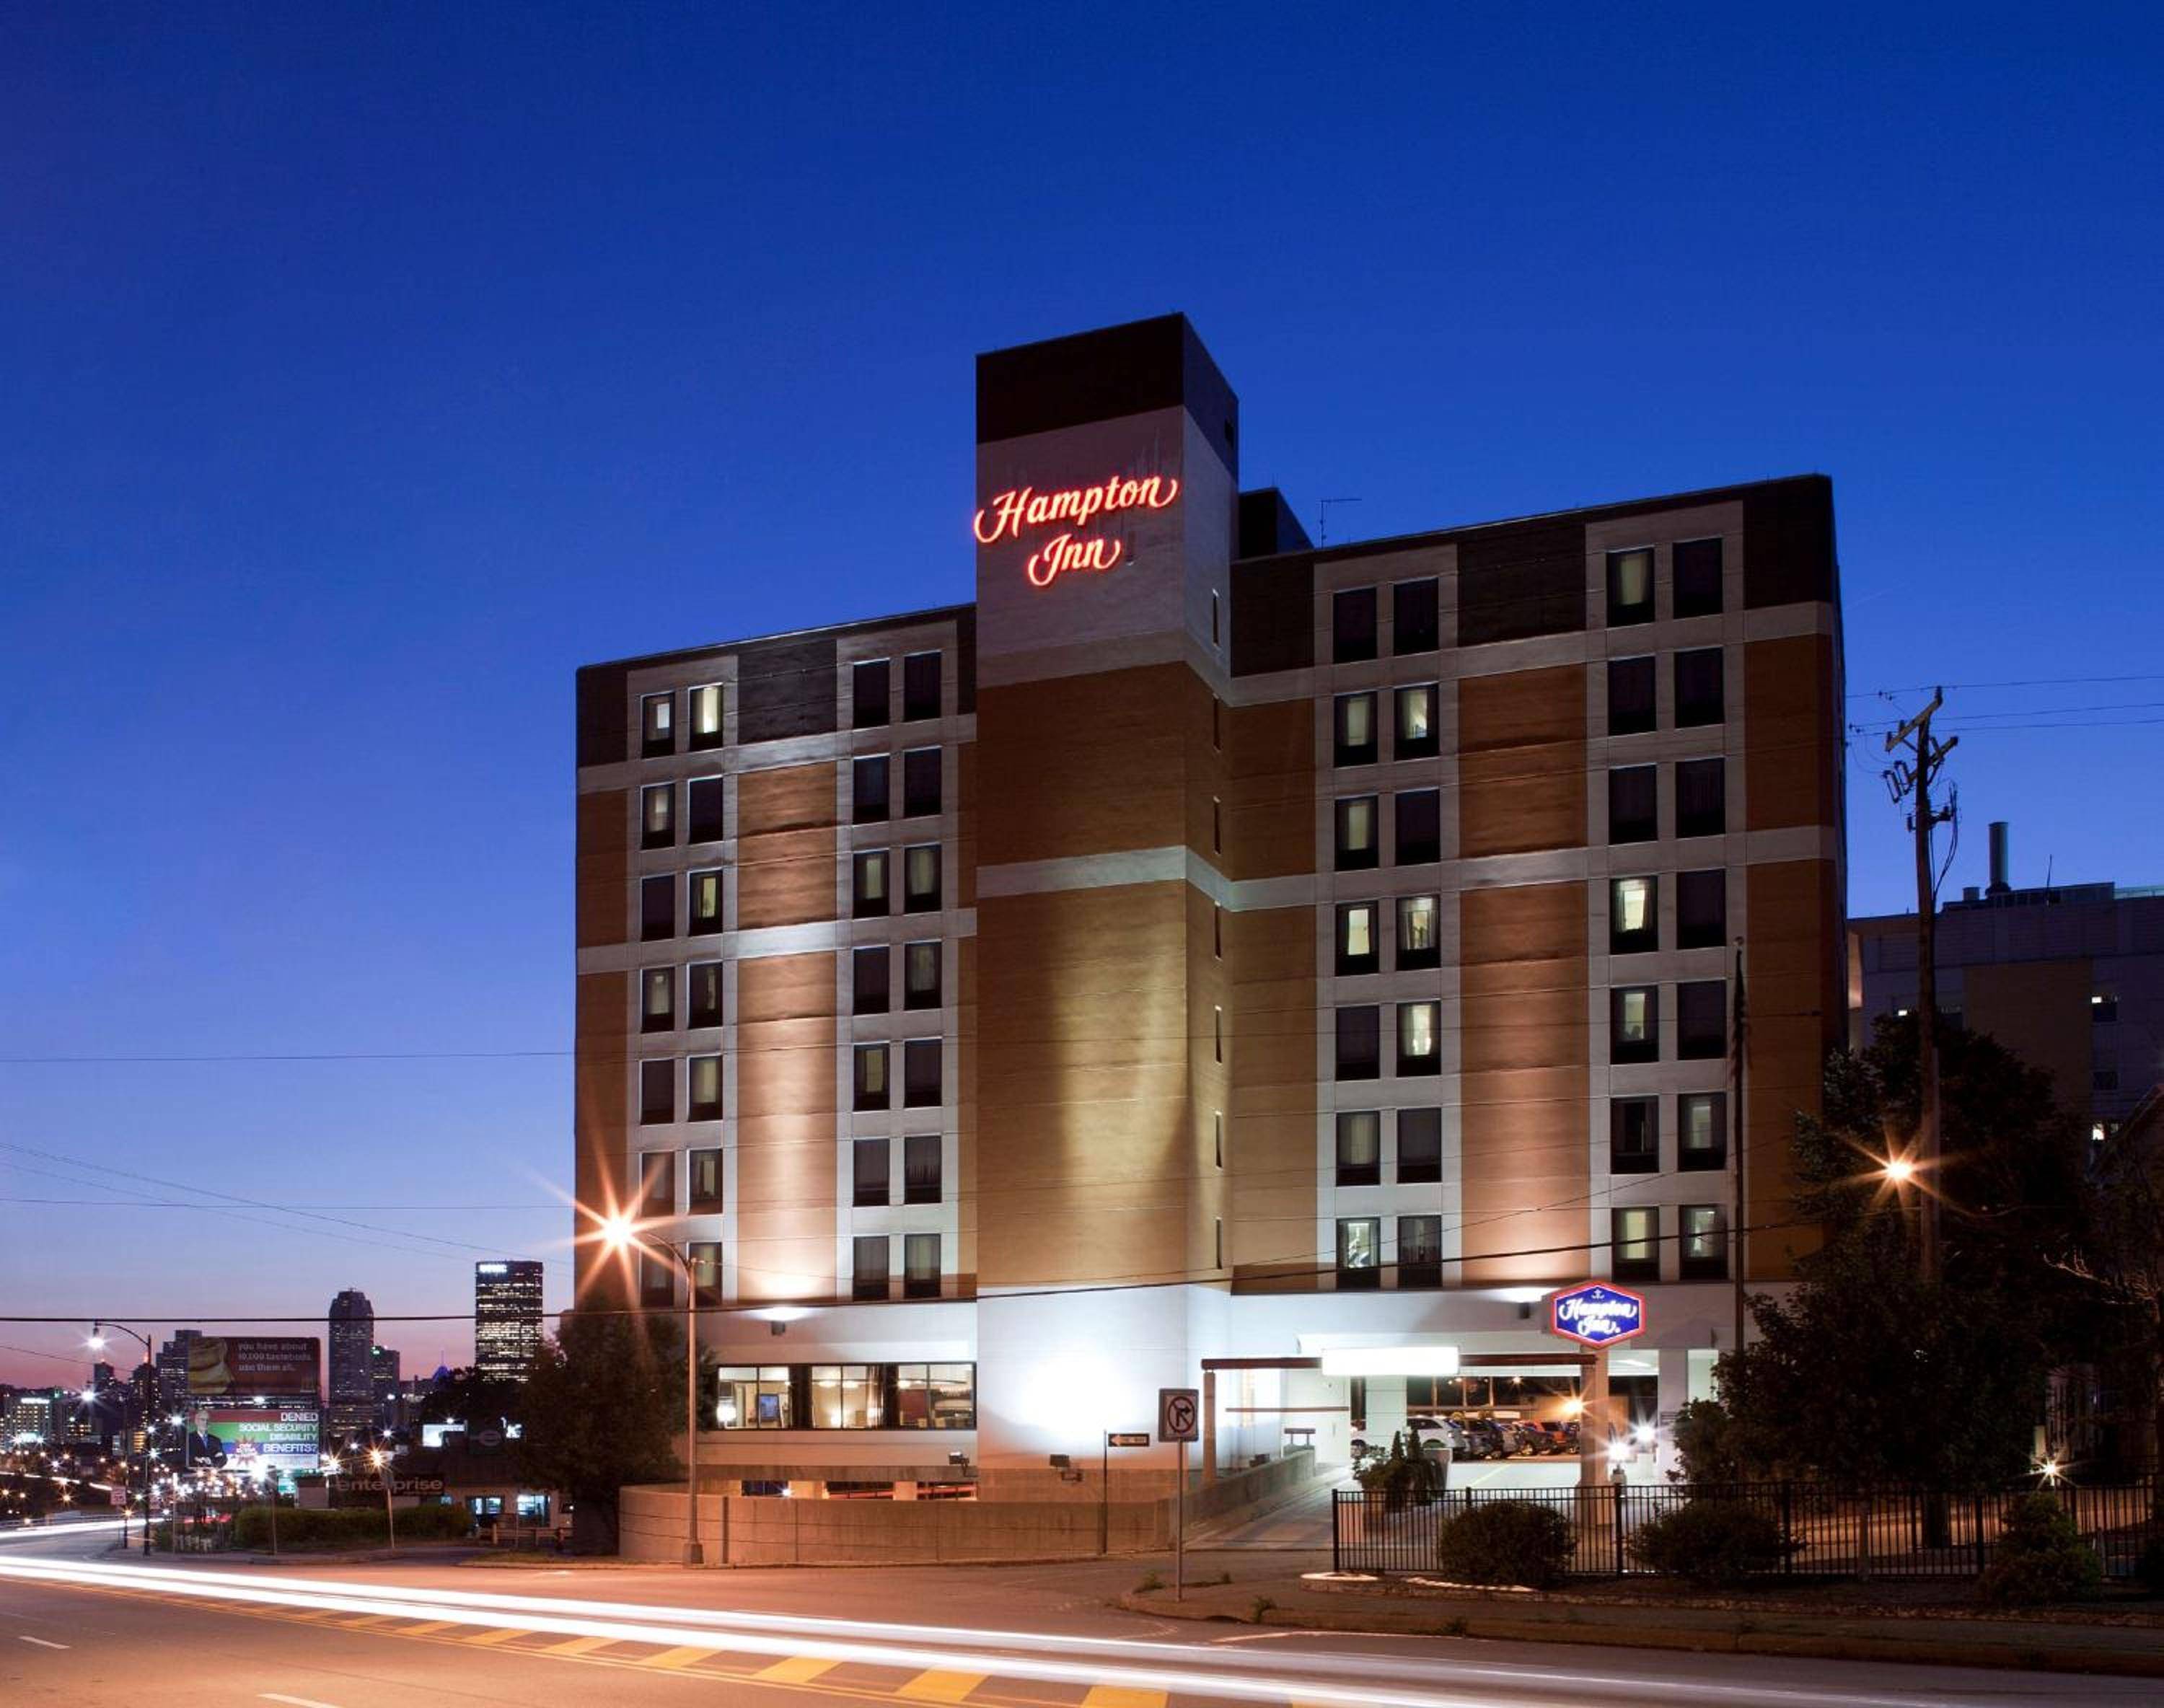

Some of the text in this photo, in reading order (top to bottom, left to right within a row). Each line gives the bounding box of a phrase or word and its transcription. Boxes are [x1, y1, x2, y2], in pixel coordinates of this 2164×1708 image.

[974, 475, 1178, 543] Hampton
[1027, 532, 1121, 586] Inn
[1558, 1298, 1637, 1321] Hampton
[1577, 1315, 1617, 1336] Inn
[239, 1422, 318, 1432] SOCIAL SECURITY
[281, 1412, 318, 1422] DENIED
[263, 1443, 318, 1453] BENEFITS?
